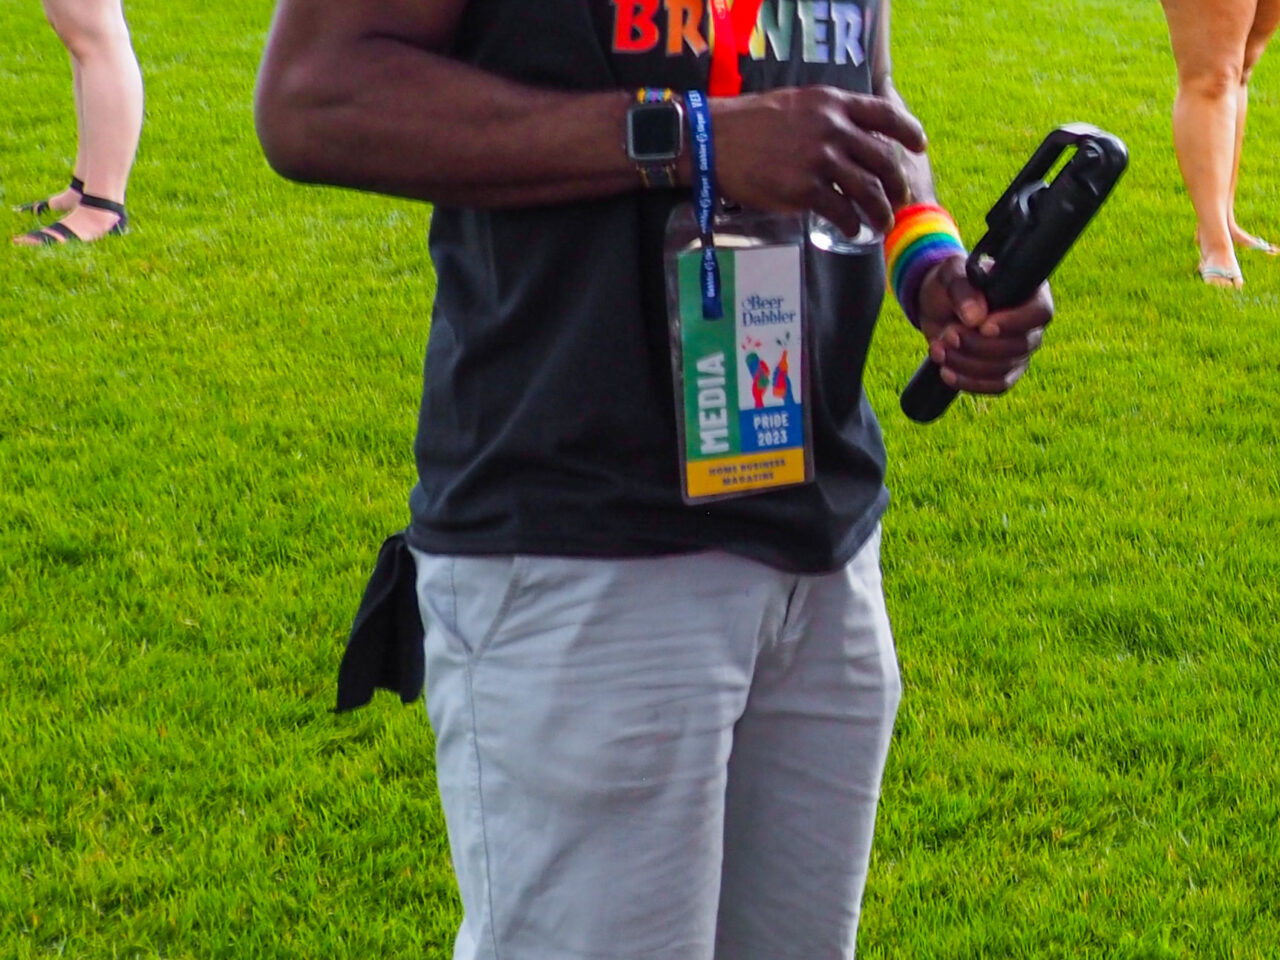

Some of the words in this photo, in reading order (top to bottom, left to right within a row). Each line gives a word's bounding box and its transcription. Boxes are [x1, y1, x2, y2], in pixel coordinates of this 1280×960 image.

[741, 294, 784, 310] Beer
[742, 310, 796, 327] Dabbler
[697, 351, 730, 455] MEDIA
[753, 411, 789, 429] PRIDE
[758, 429, 788, 447] 2023
